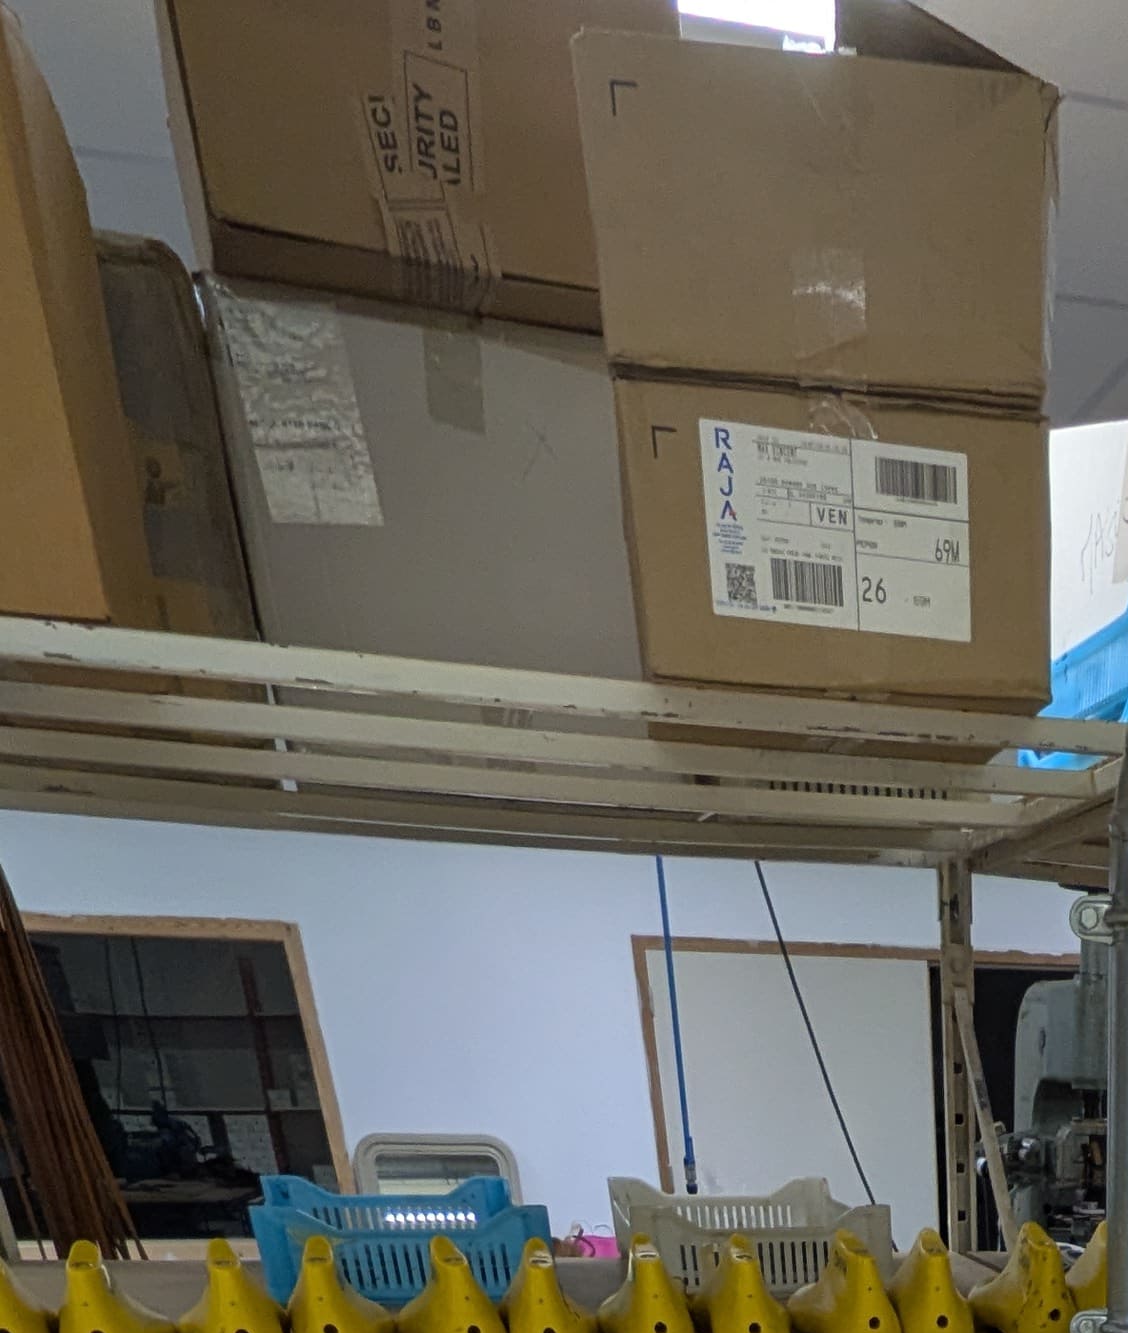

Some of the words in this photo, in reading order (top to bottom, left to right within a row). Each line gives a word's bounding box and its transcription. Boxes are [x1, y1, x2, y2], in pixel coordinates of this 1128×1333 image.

[714, 426, 738, 522] RAJA
[816, 506, 849, 526] VEN
[934, 537, 960, 565] 69M
[861, 576, 887, 604] 26
